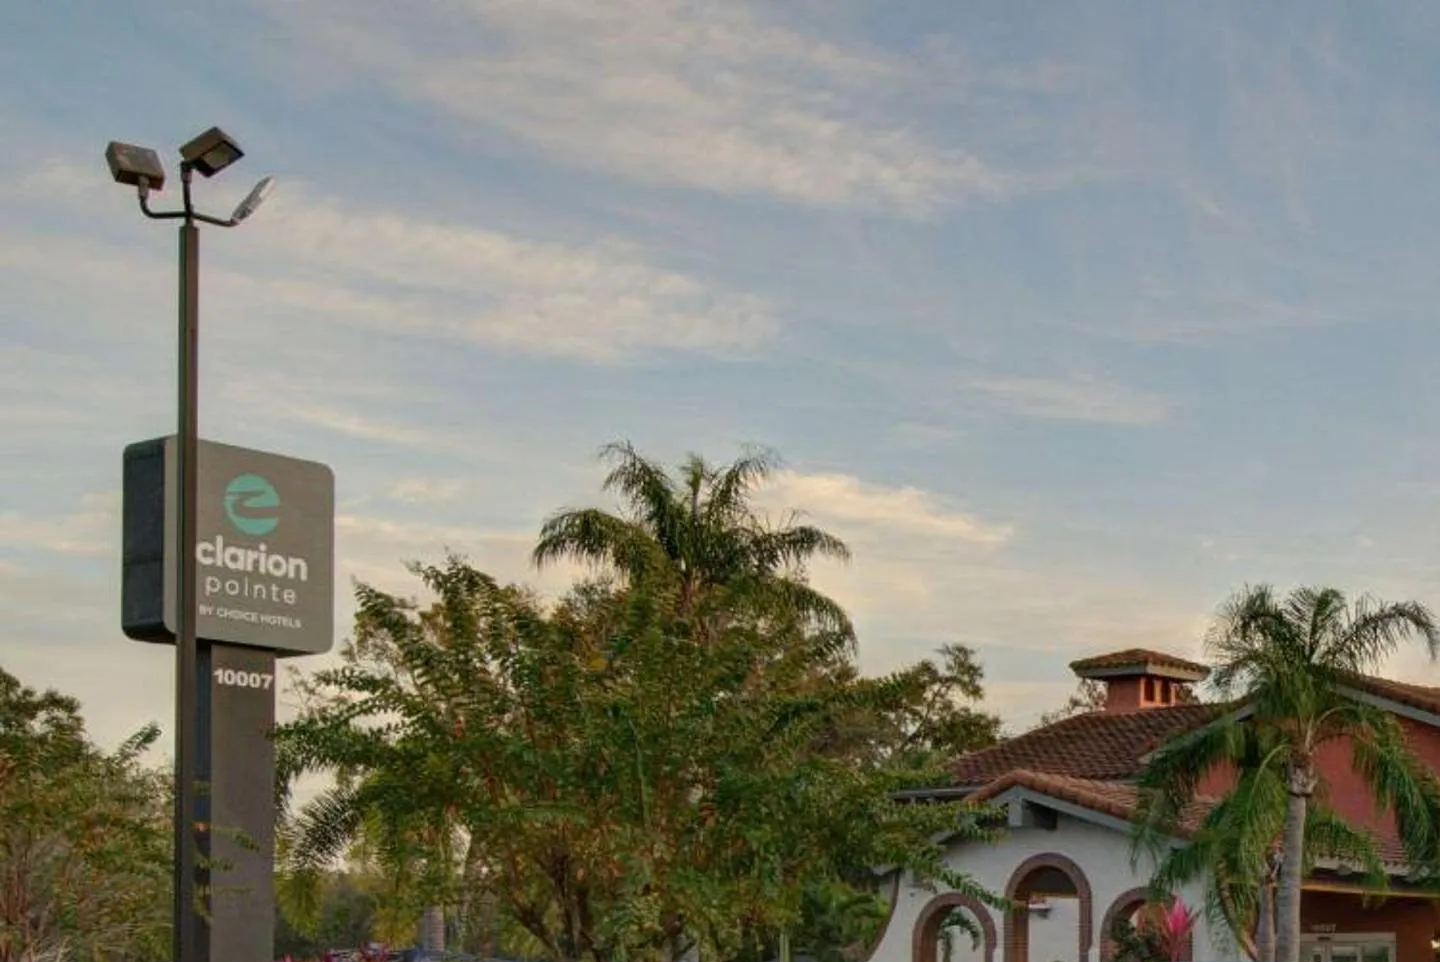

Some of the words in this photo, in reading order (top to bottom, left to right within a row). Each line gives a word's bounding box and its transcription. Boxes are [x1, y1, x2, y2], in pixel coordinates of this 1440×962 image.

[196, 534, 308, 582] clarion
[204, 575, 296, 604] pointe
[260, 613, 301, 629] HOTELS
[213, 667, 273, 689] 10007
